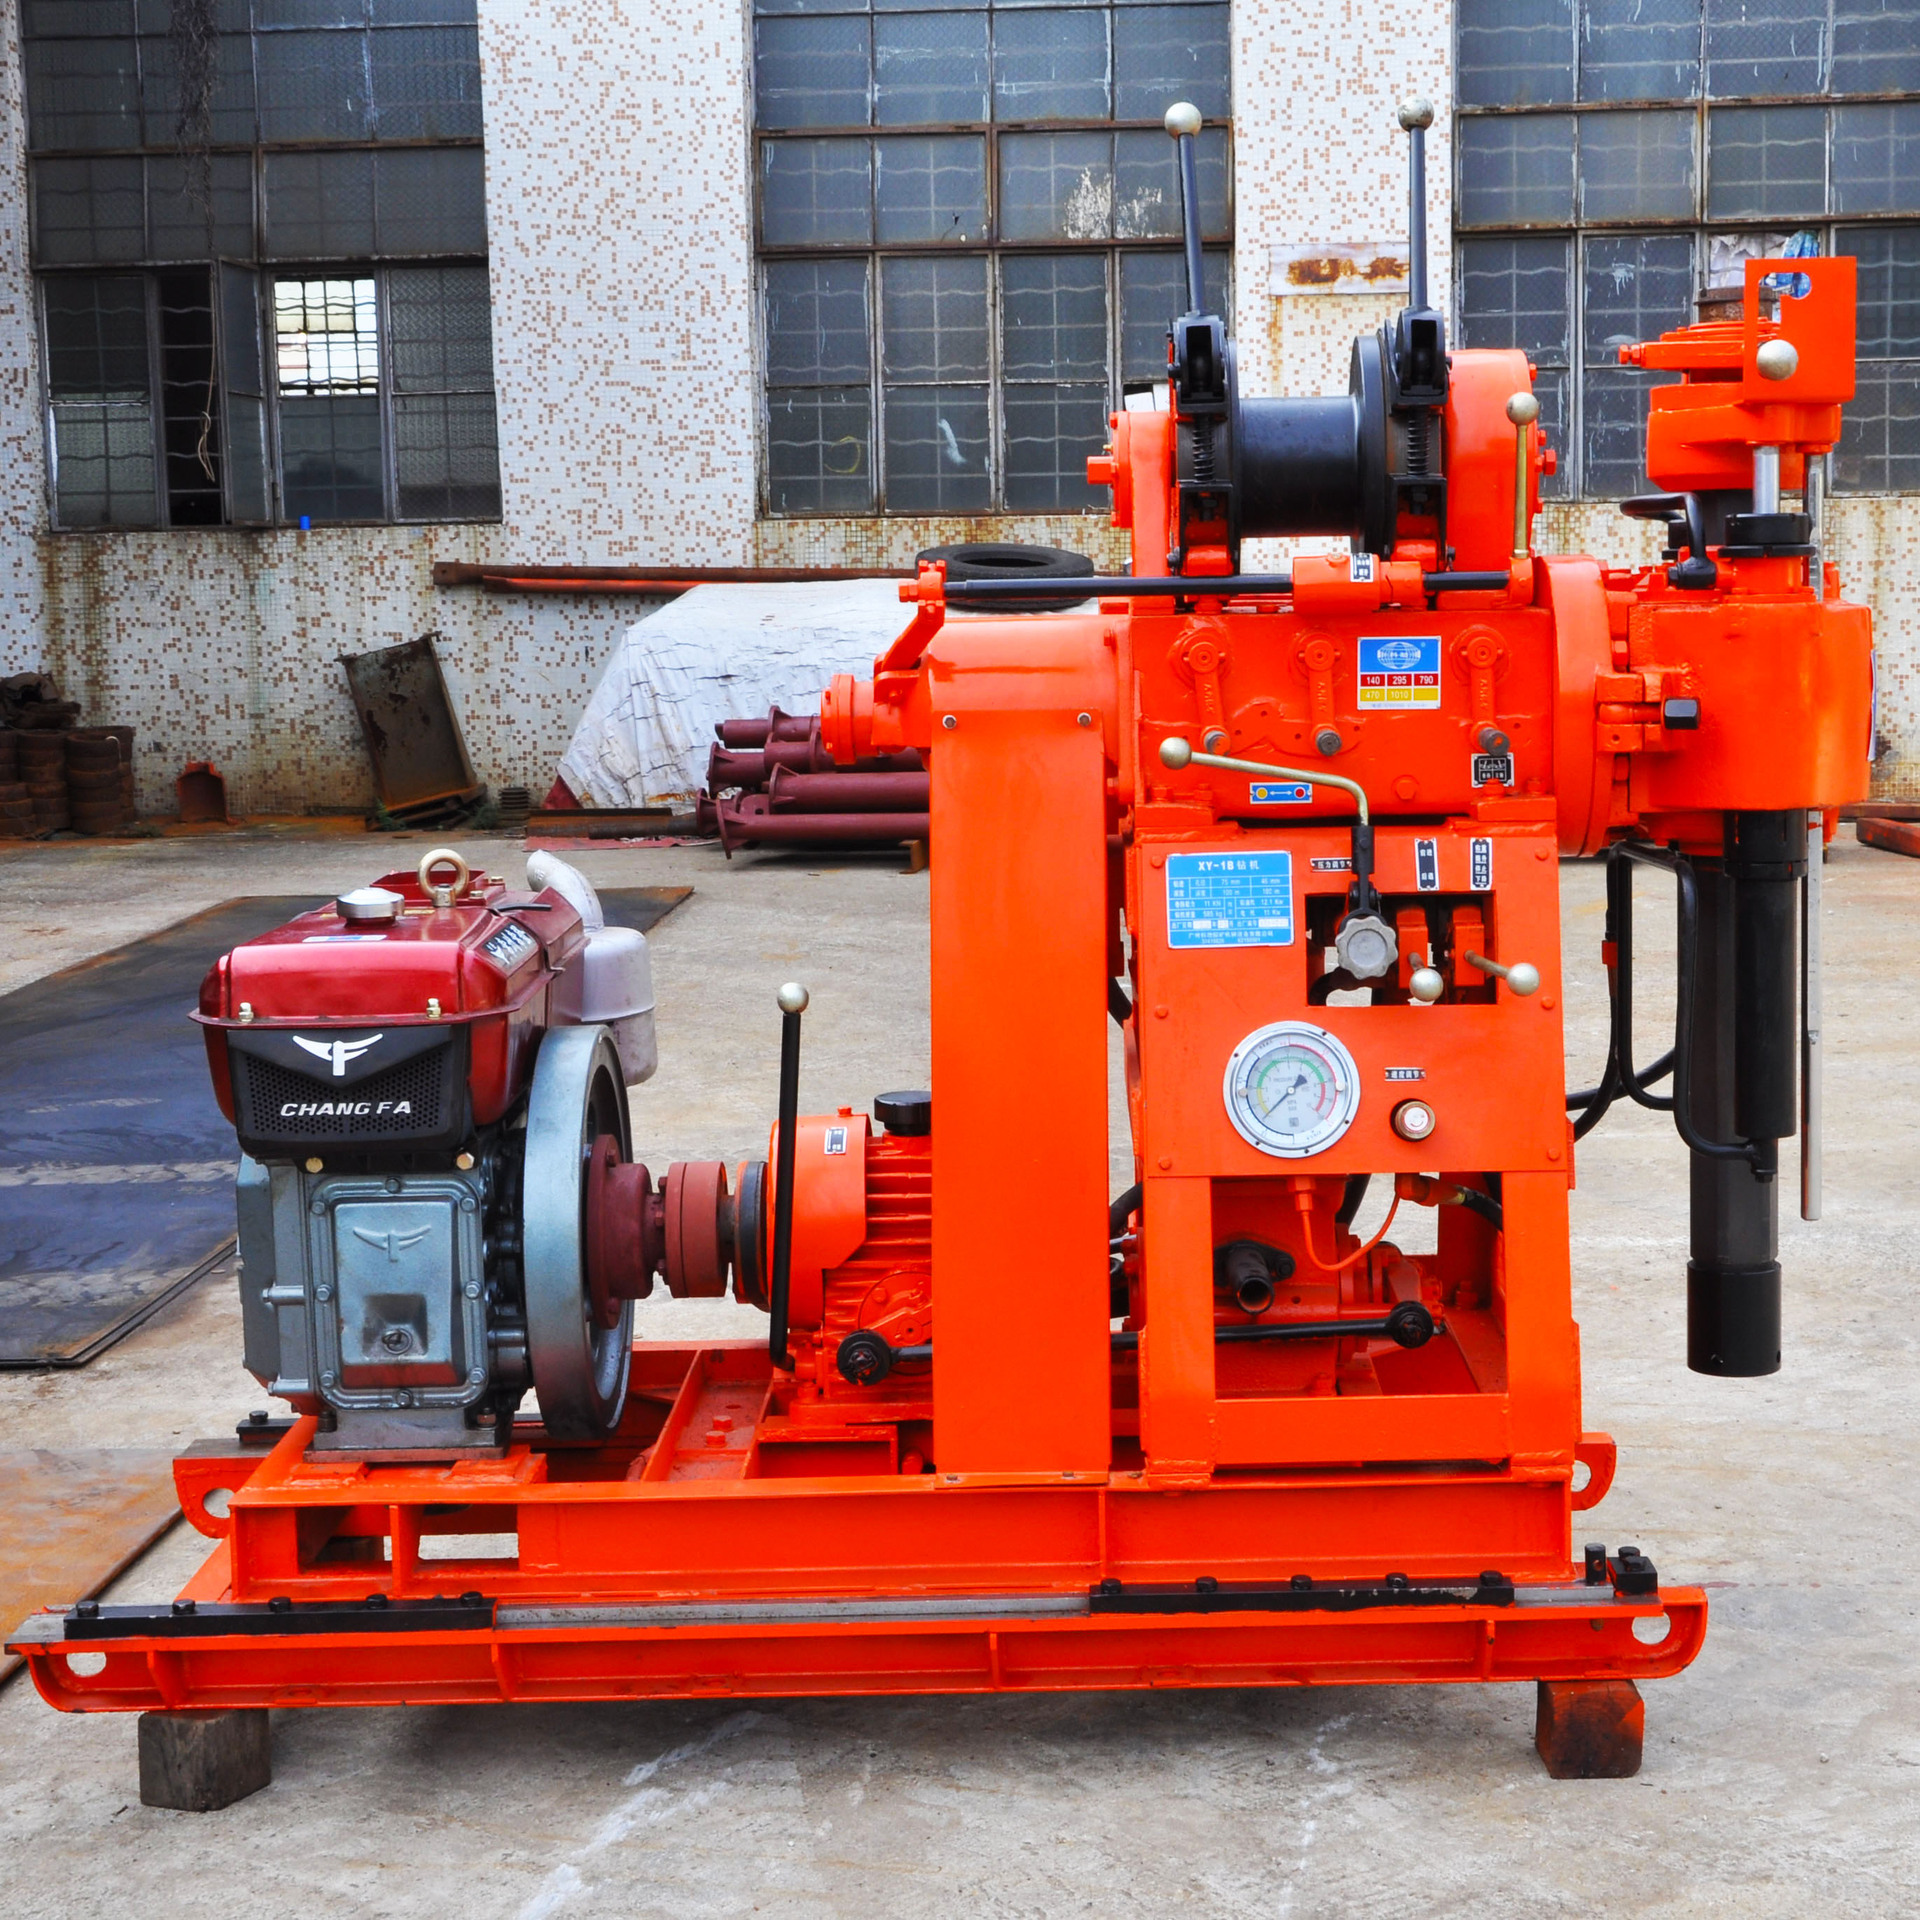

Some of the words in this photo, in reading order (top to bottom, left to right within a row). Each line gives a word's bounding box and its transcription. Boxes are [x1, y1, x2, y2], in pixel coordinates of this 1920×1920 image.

[1366, 676, 1381, 685] 140
[1392, 675, 1407, 685] 295
[1419, 675, 1434, 684] 790
[1365, 691, 1380, 699] 470
[1391, 690, 1409, 699] 1010
[1198, 860, 1235, 871] XY-1B
[1237, 860, 1260, 870] 钻机
[1317, 860, 1346, 869] 压力调节
